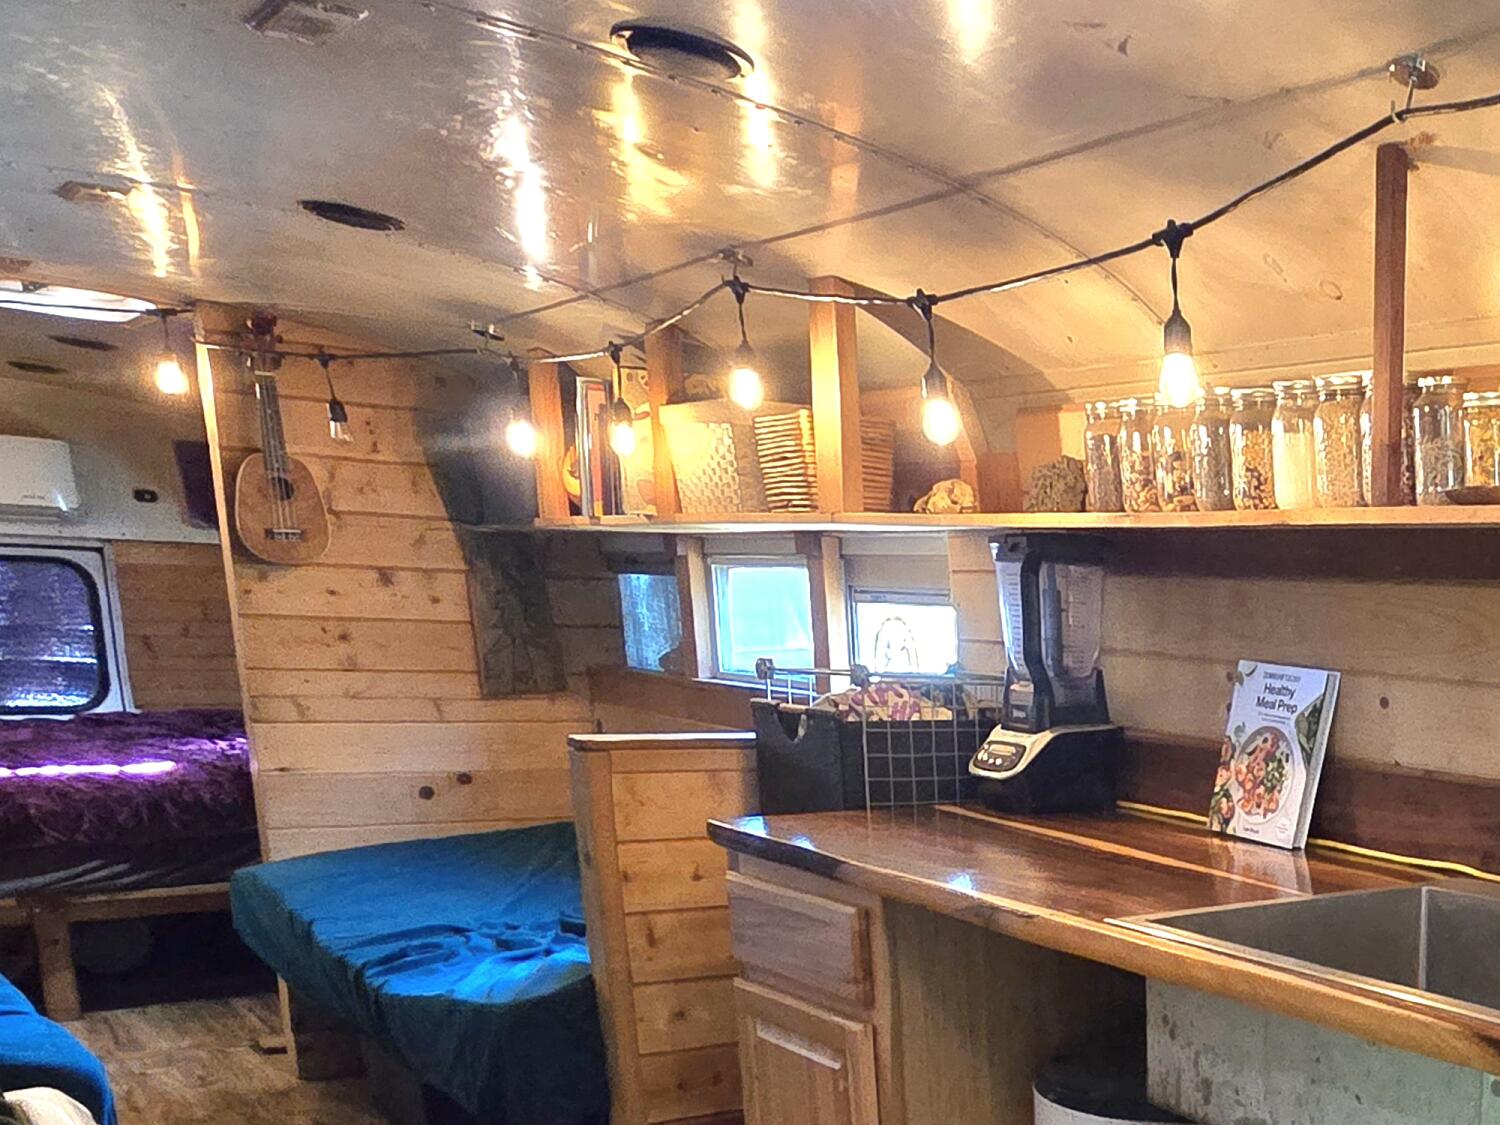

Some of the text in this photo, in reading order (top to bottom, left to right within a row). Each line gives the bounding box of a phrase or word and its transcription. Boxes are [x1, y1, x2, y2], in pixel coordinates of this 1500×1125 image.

[1263, 682, 1296, 701] Healthy
[1256, 696, 1298, 715] Meal Prep
